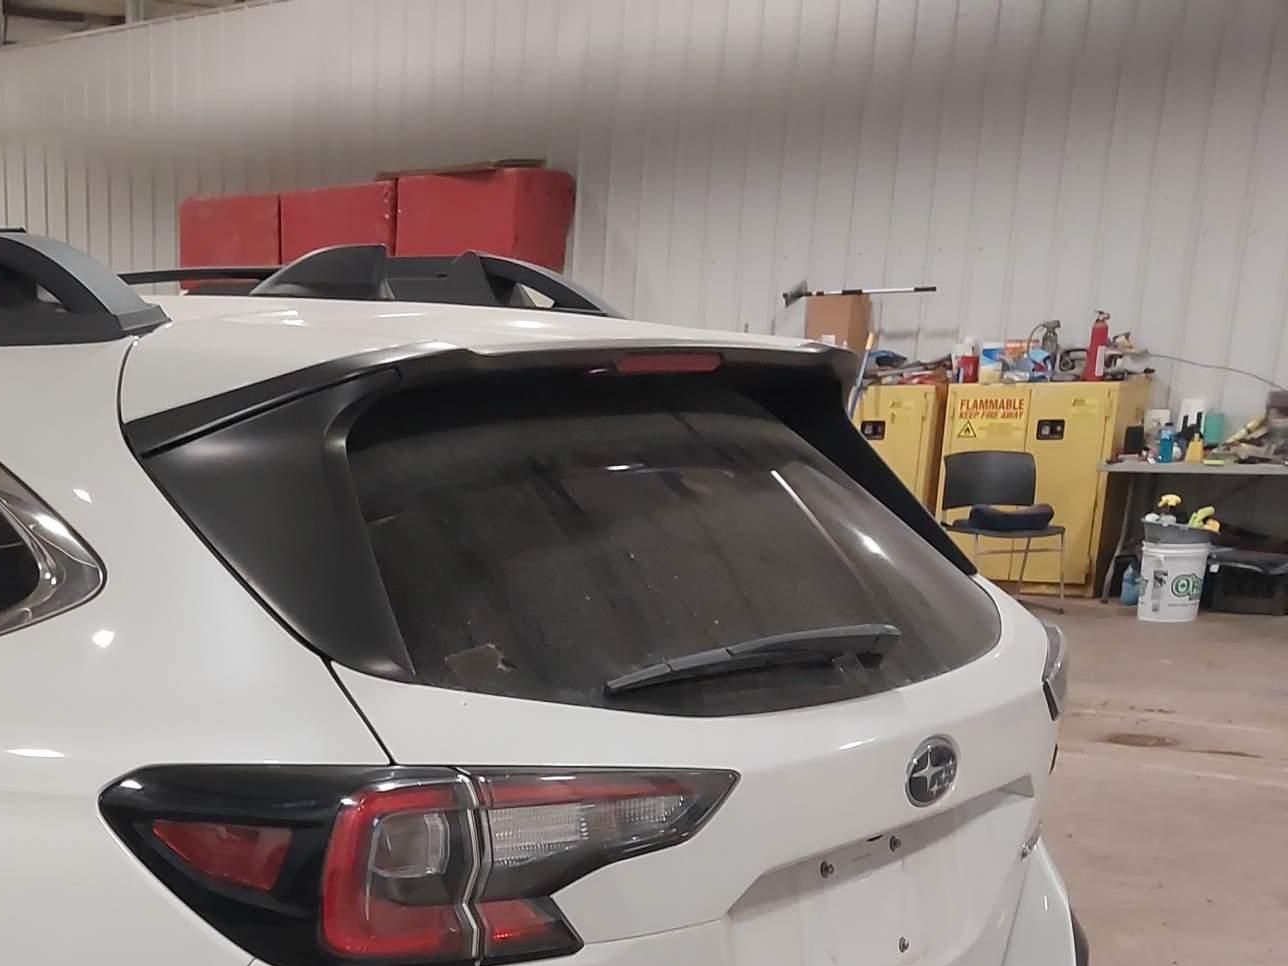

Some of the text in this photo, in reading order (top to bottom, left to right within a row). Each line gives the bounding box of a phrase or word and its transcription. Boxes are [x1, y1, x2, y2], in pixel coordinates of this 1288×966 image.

[959, 398, 1025, 411] FLAMMABLE
[959, 410, 1024, 420] KEEP FIRE AWAY
